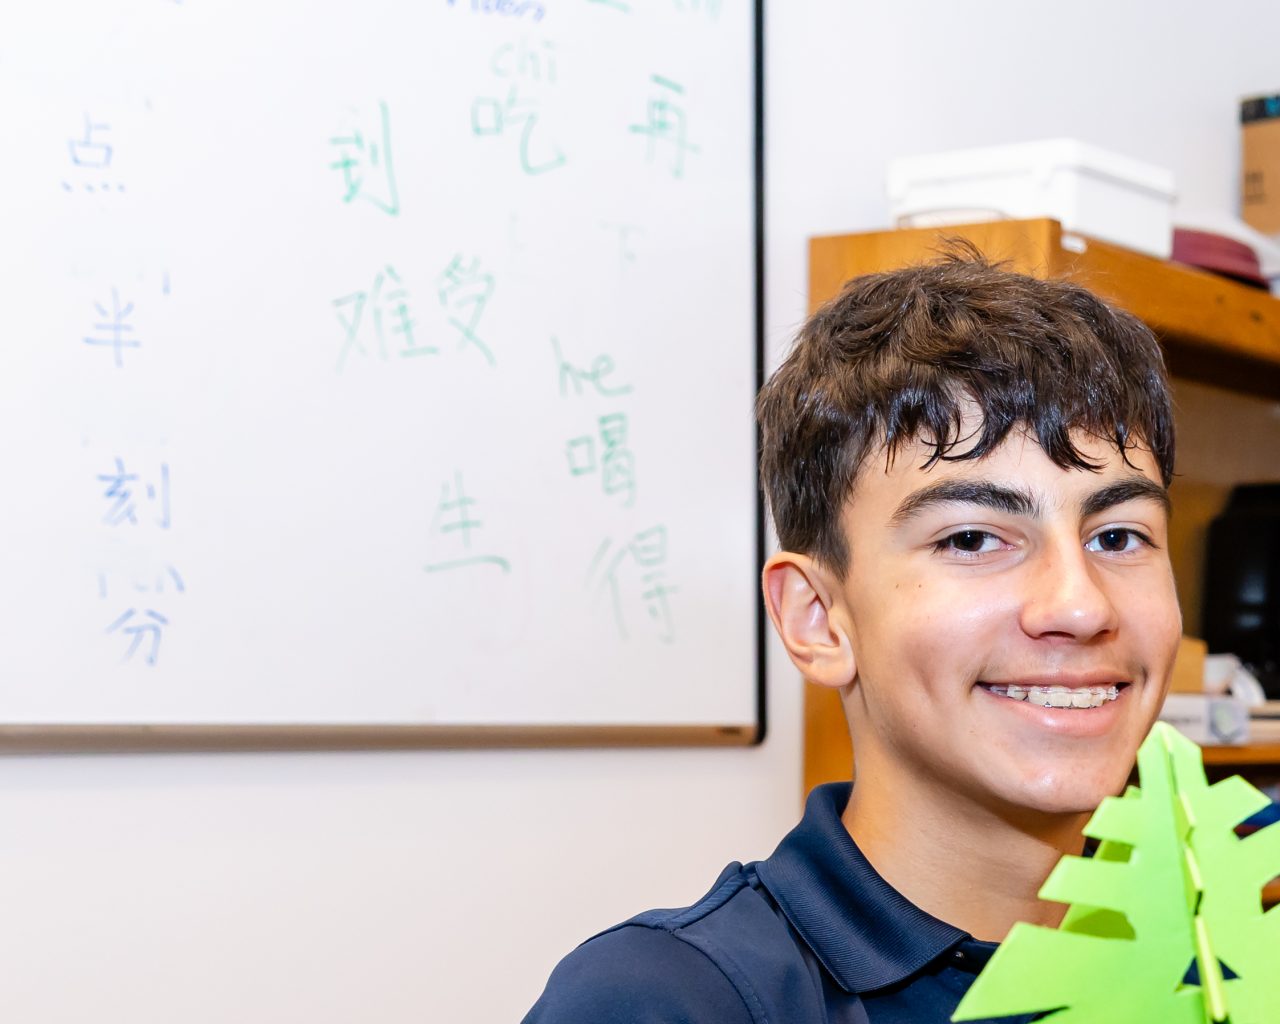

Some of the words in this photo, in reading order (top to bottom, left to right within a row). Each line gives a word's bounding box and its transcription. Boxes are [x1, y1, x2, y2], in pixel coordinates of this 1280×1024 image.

[60, 109, 127, 194] 点
[328, 98, 401, 217] 到
[469, 83, 569, 177] 吃
[626, 72, 702, 181] 再
[81, 284, 143, 369] 半
[331, 252, 498, 374] 难受
[549, 334, 635, 399] he
[95, 455, 172, 531] 刻
[564, 411, 638, 509] 喝
[422, 468, 513, 575] 生
[582, 522, 684, 646] 得
[104, 606, 171, 668] 分
